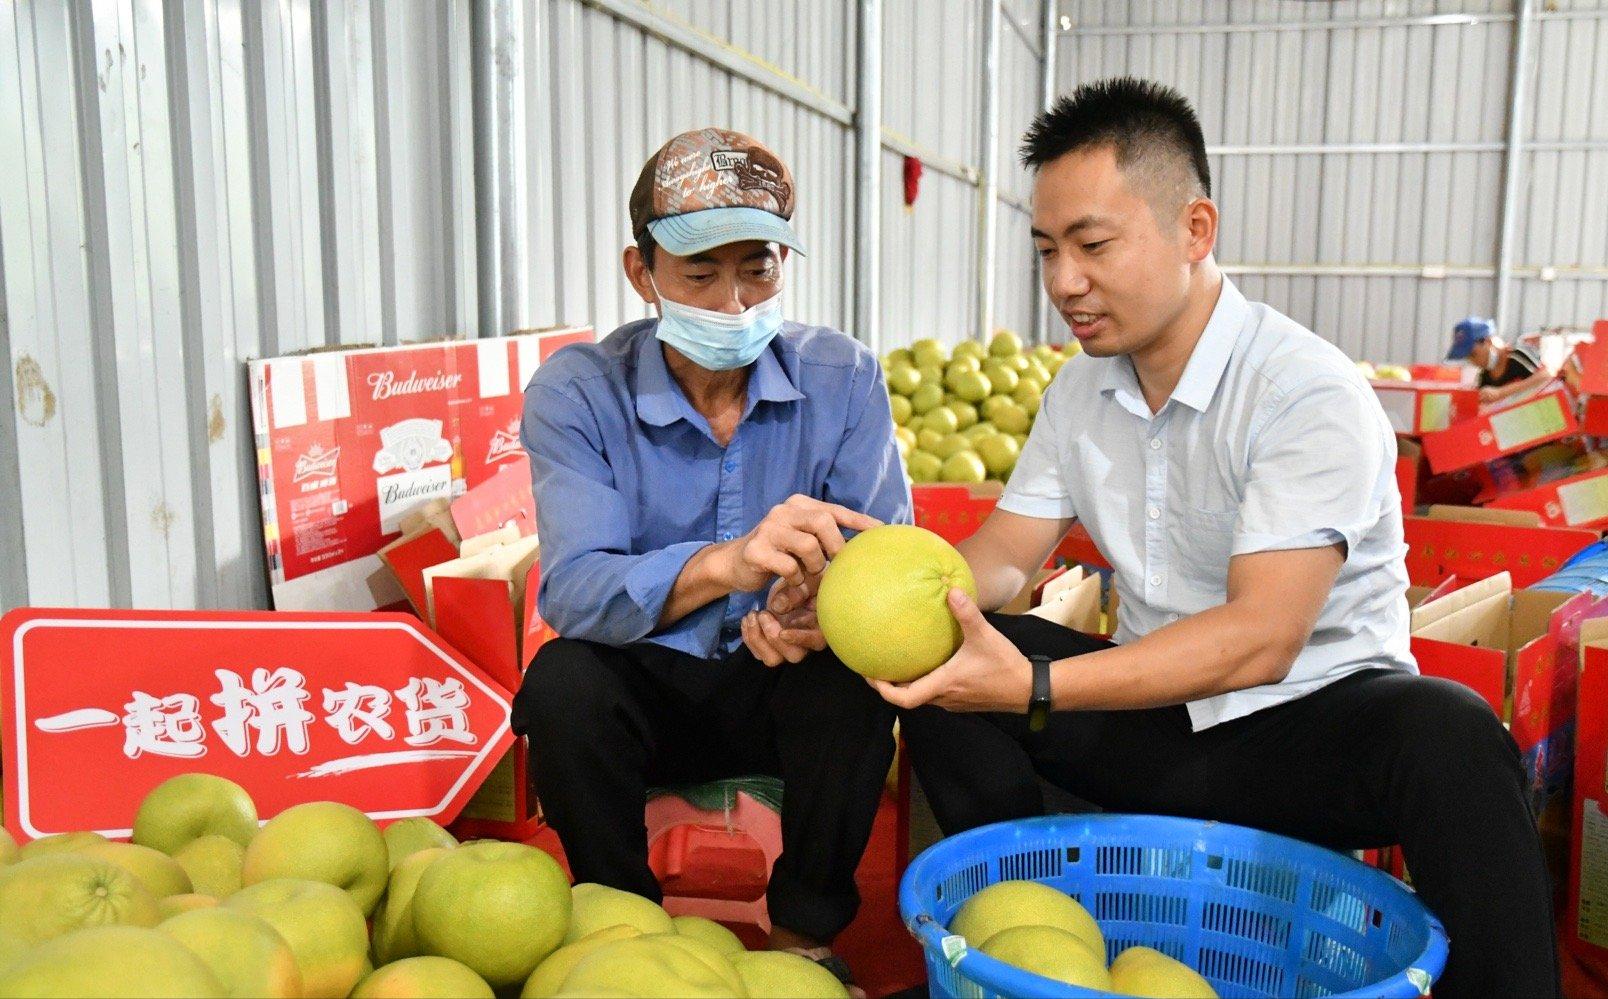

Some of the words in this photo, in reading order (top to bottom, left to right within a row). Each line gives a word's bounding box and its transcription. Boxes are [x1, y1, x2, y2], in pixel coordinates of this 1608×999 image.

[367, 370, 463, 400] Budweiser
[382, 478, 447, 504] Budweiser
[35, 667, 478, 758] 一起拼农货
